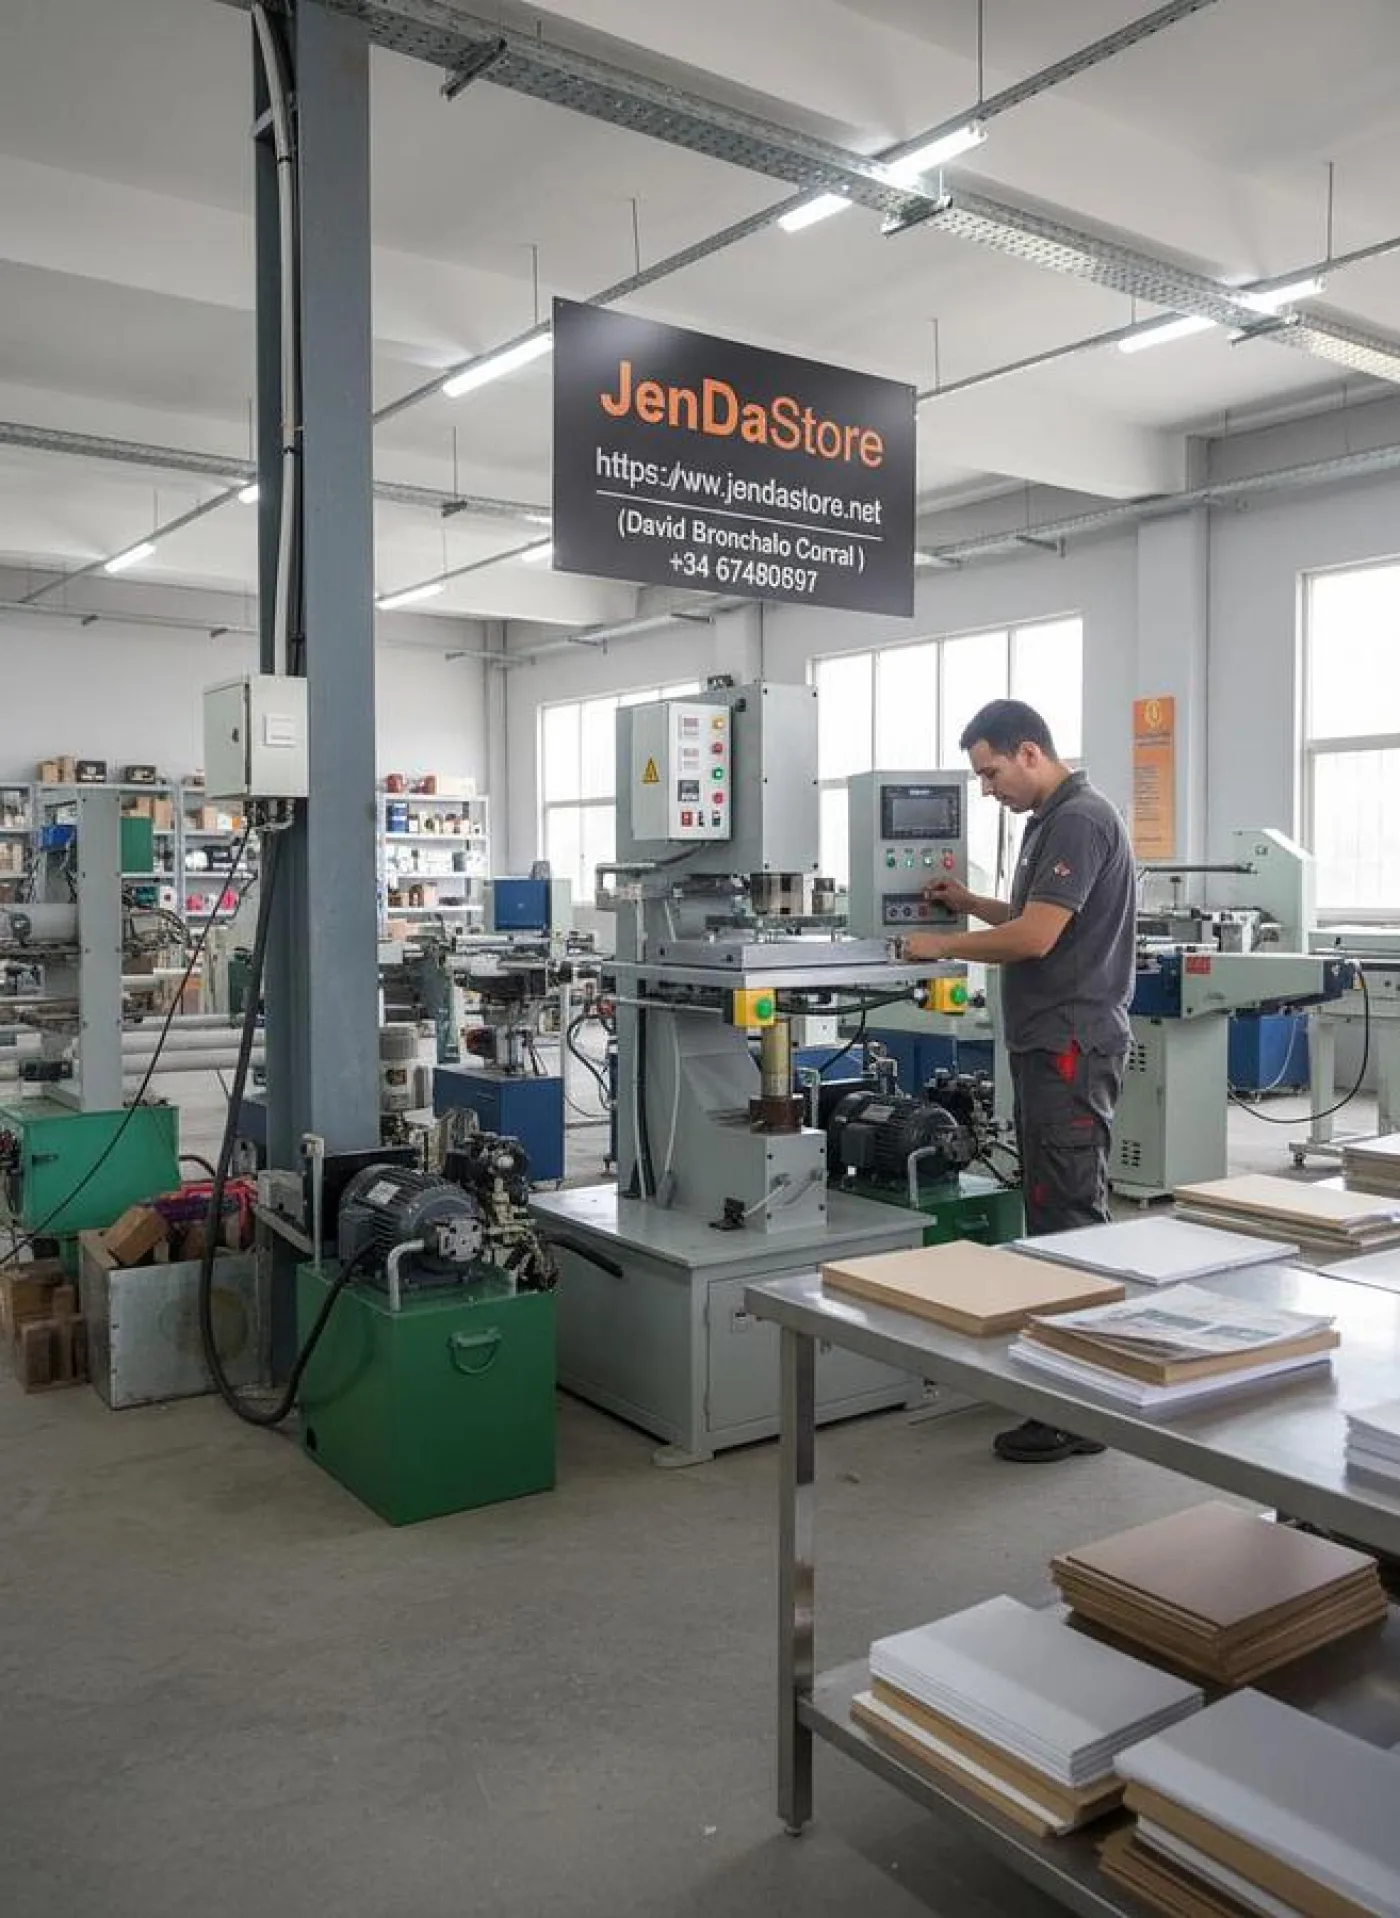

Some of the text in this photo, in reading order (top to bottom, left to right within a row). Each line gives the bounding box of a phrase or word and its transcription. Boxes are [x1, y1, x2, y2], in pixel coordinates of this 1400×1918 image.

[600, 360, 884, 468] JenDaStore
[618, 508, 685, 538] (David
[692, 519, 791, 557] Bronchalo
[669, 551, 709, 578] +34
